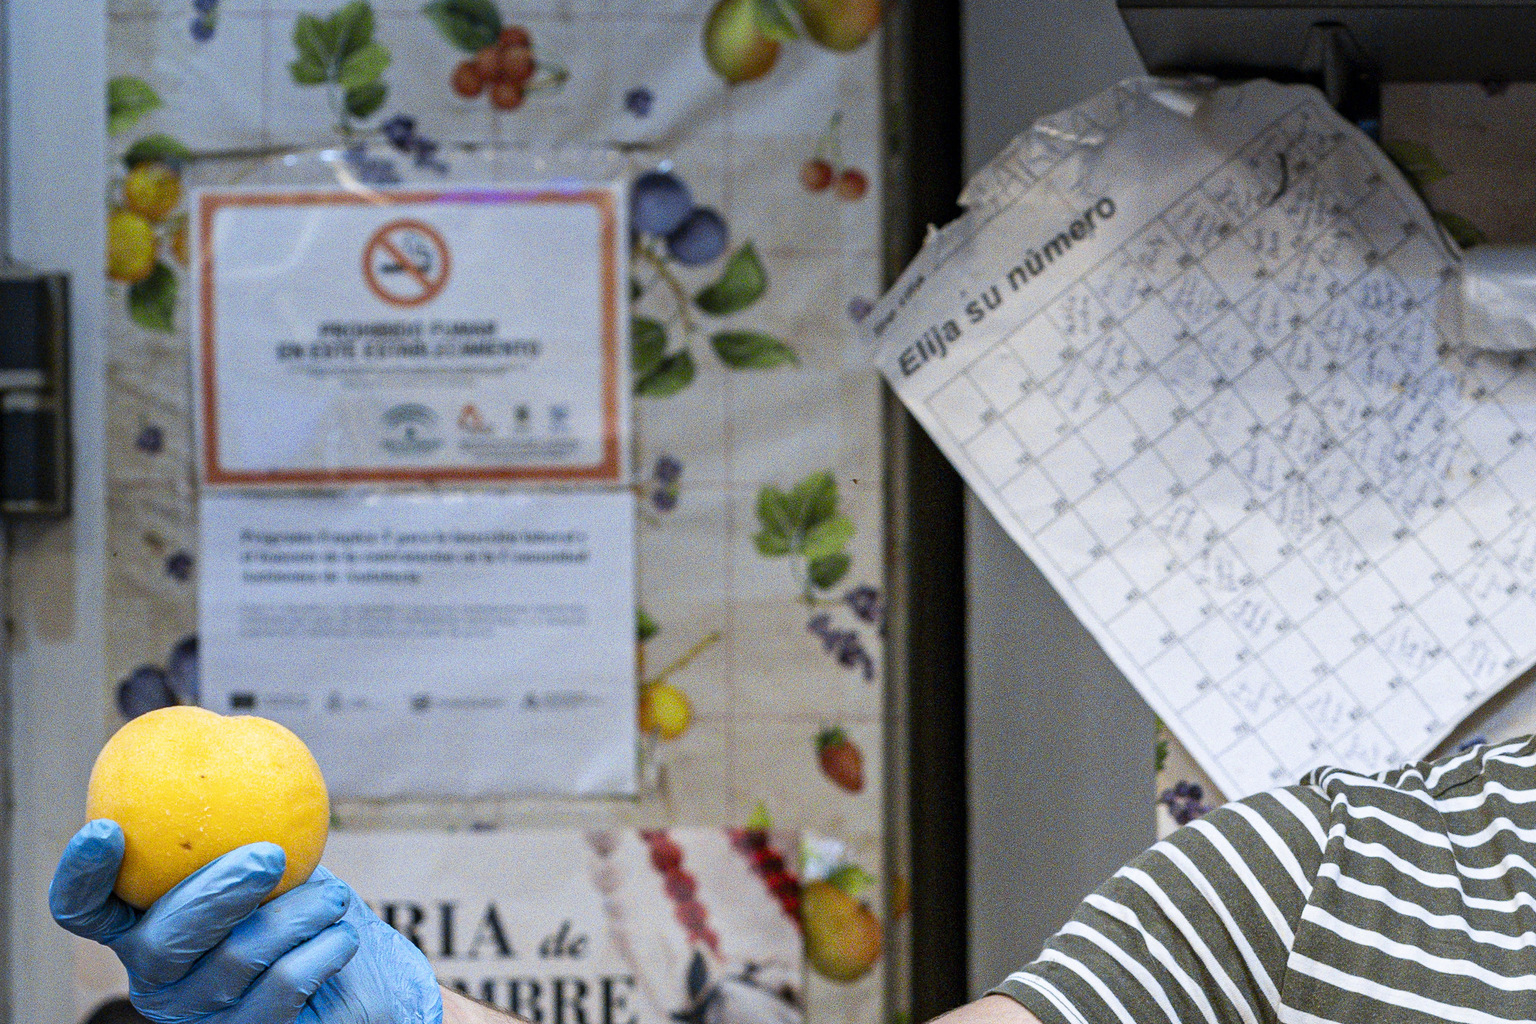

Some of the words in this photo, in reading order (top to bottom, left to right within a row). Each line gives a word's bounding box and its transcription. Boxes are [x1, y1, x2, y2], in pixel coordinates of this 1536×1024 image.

[899, 319, 962, 377] Elija
[965, 285, 1003, 325] su
[1006, 198, 1116, 291] número
[383, 902, 515, 958] RIA
[539, 919, 588, 957] de
